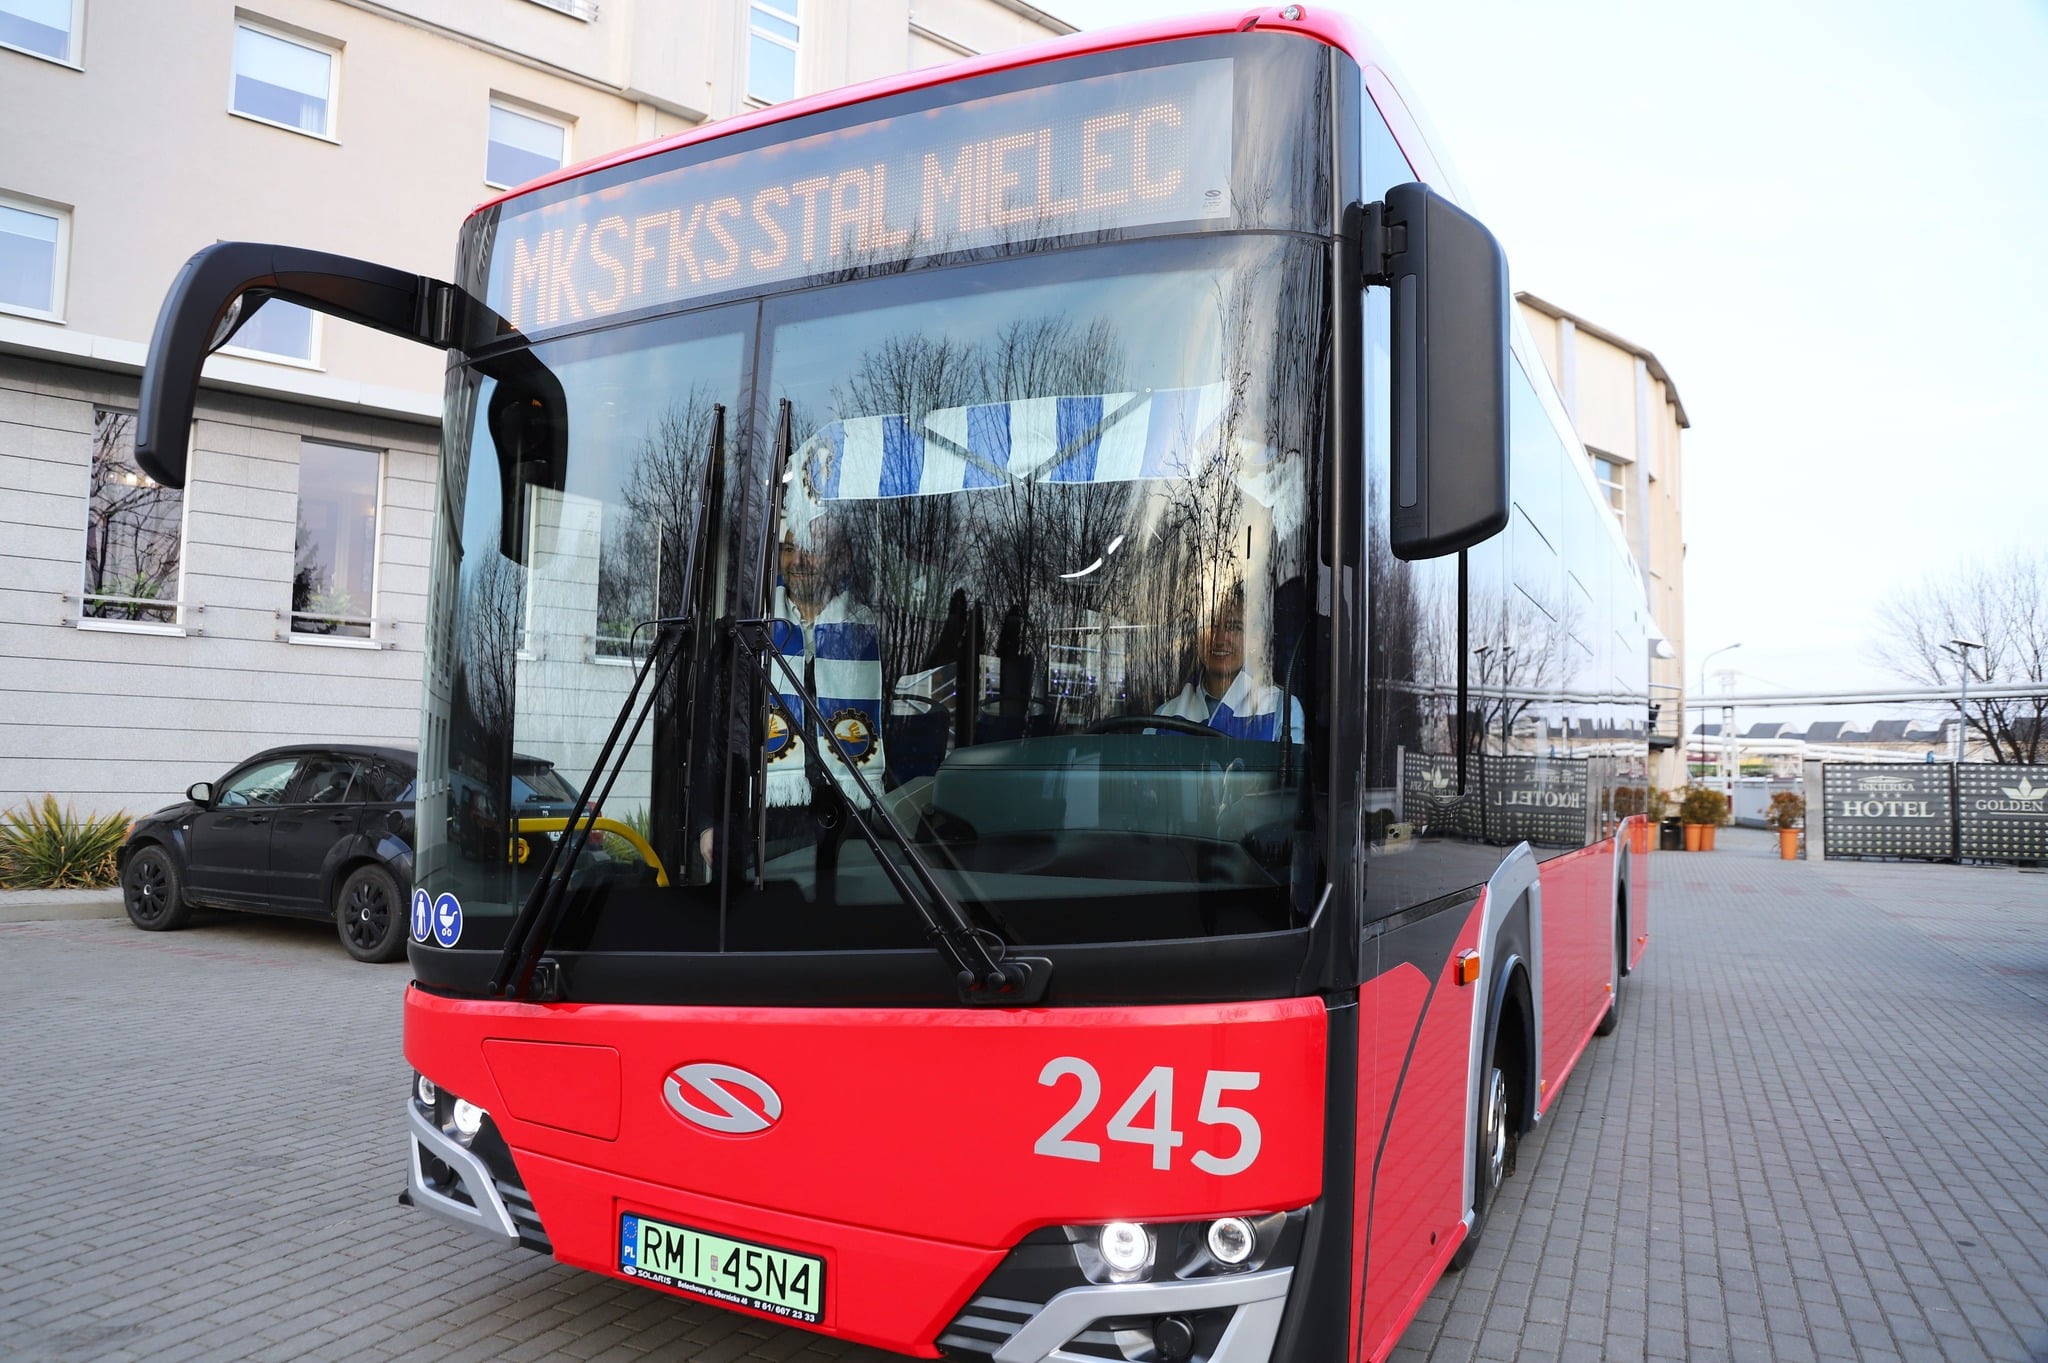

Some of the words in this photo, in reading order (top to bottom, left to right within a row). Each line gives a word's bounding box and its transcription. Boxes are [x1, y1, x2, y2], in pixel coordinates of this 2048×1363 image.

[749, 163, 909, 271] STAL
[921, 102, 1182, 240] MIELEC
[1858, 783, 1916, 792] ISKIERKA
[1841, 800, 1937, 818] HOTEL
[1975, 799, 2044, 812] GOLDEN
[1033, 1055, 1262, 1177] 245
[624, 1245, 636, 1259] PL
[643, 1225, 700, 1277] RMI
[722, 1247, 810, 1306] 45N4
[637, 1269, 672, 1285] SOLARIS
[792, 1310, 803, 1320] 23
[804, 1312, 815, 1322] 33
